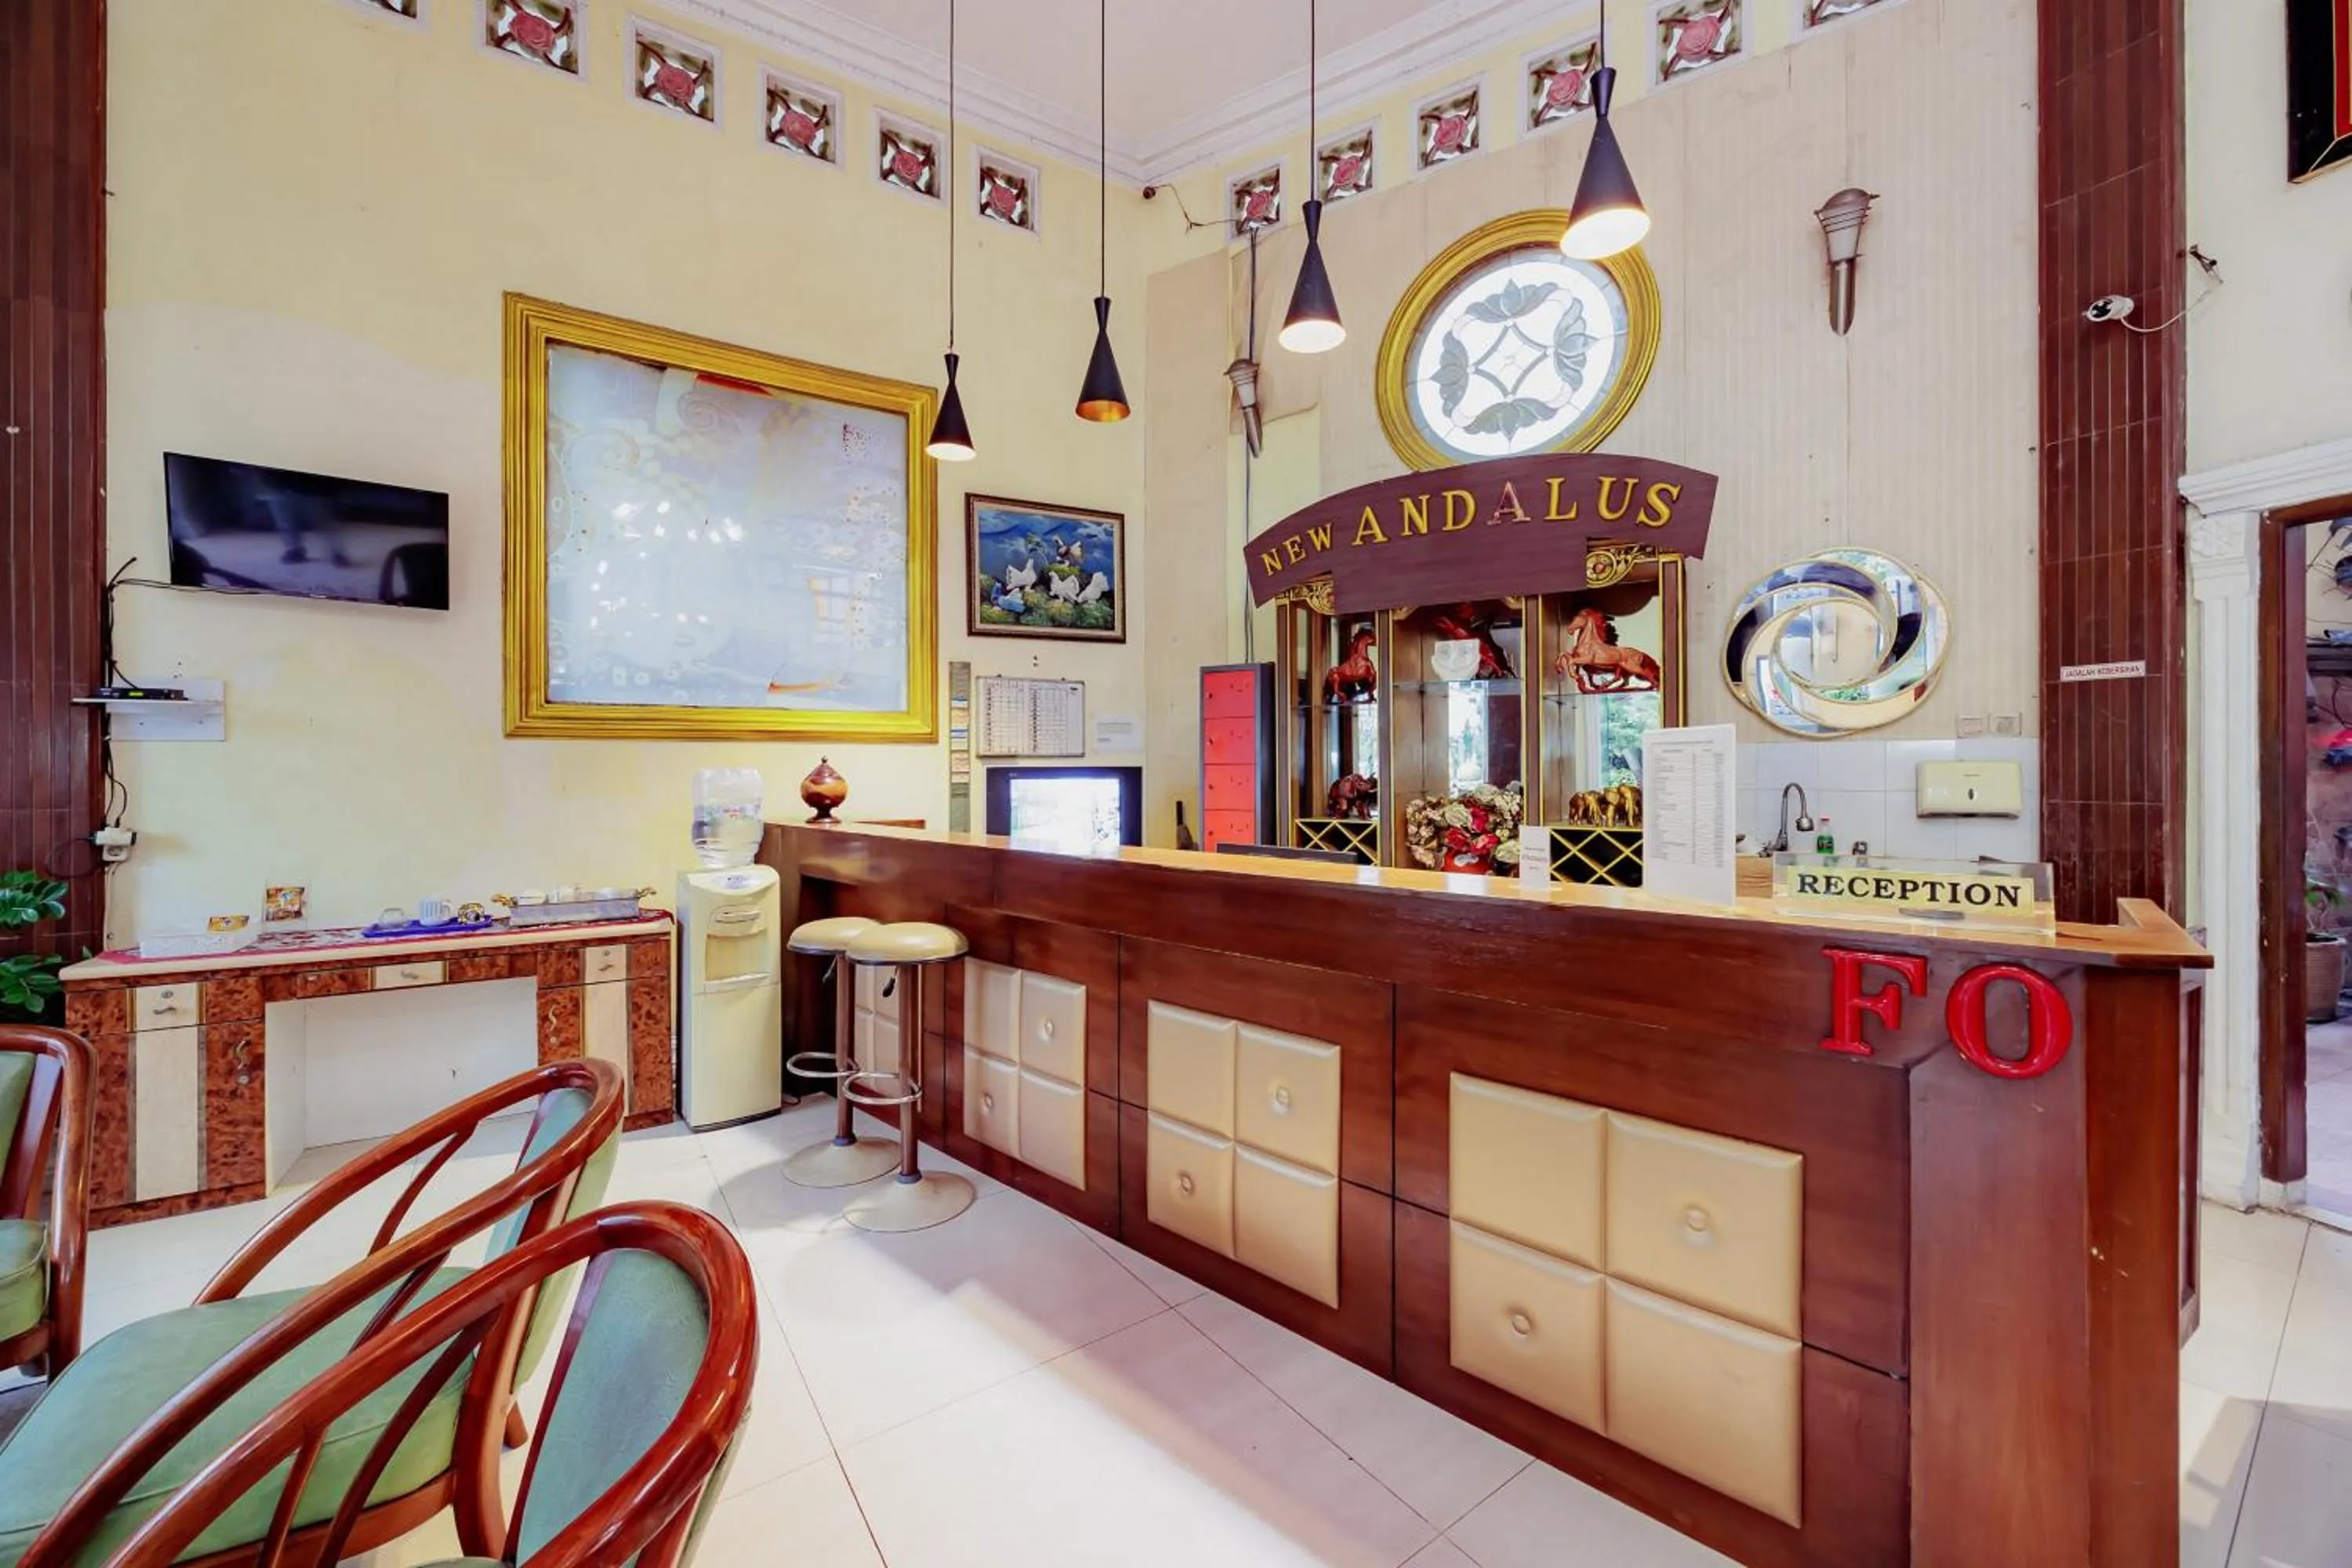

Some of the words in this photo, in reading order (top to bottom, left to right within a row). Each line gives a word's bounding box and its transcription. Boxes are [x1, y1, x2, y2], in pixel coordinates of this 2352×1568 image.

[1261, 521, 1334, 576] NEW
[1351, 475, 1683, 546] ANDALUS
[1798, 873, 2021, 908] RECEPTION
[1818, 945, 2074, 1080] FO
